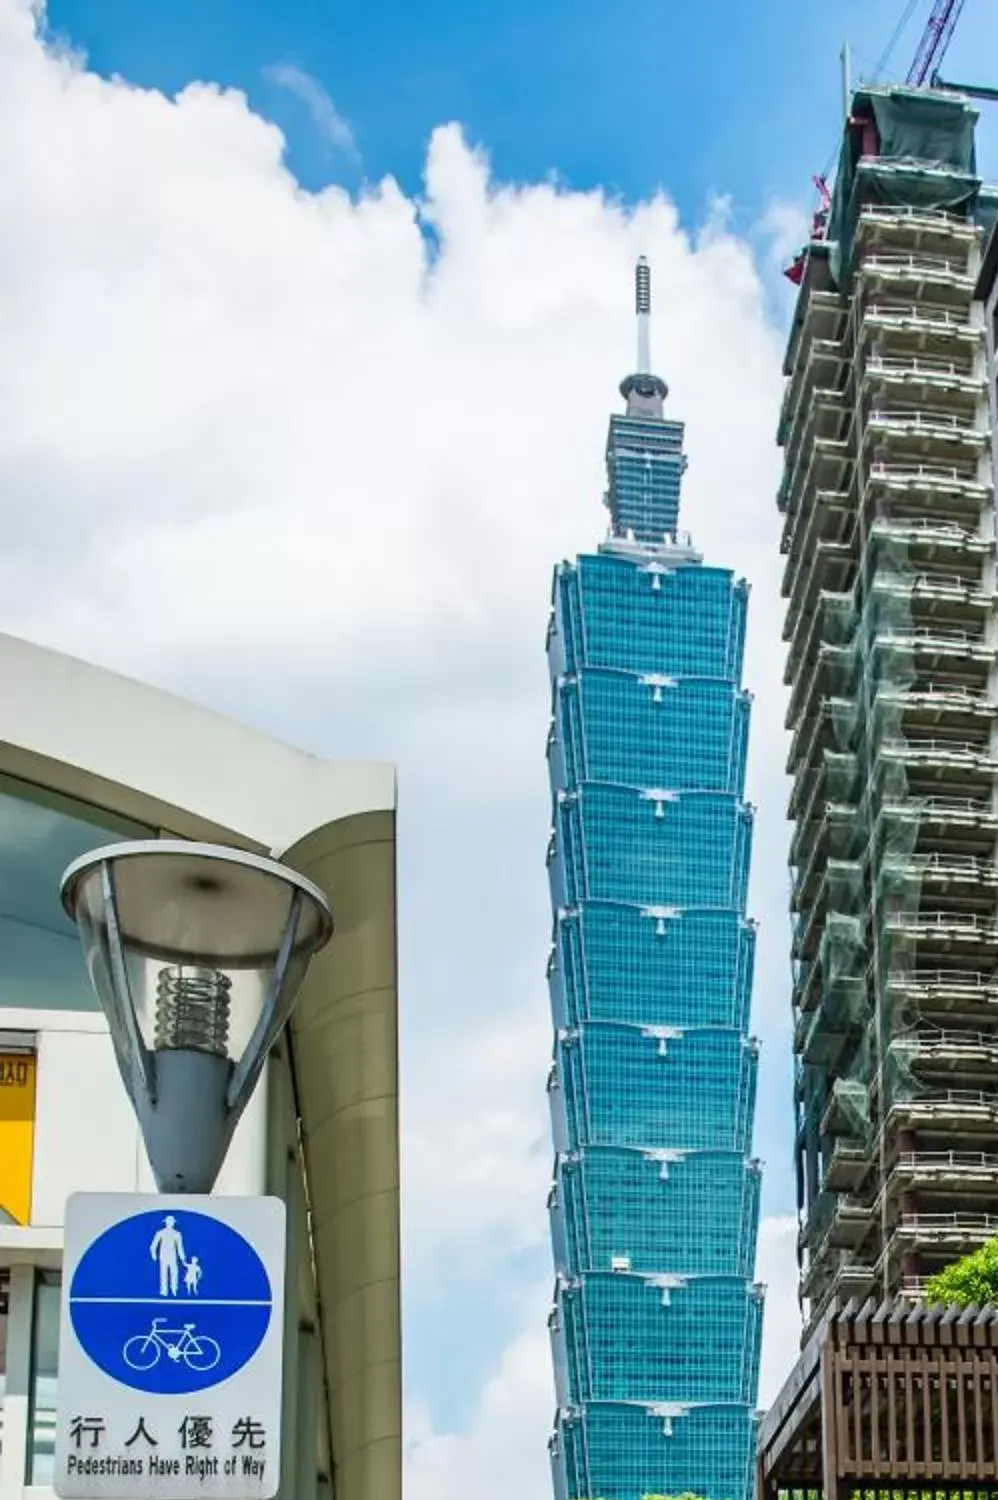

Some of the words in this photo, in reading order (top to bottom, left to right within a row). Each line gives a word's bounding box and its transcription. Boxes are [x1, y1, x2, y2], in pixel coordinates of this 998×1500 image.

[69, 1415, 266, 1449] 行人優先
[67, 1455, 143, 1476] Pedestrians
[149, 1456, 180, 1476] Have
[185, 1455, 218, 1480] Right
[223, 1455, 237, 1476] of
[241, 1455, 266, 1480] Way
